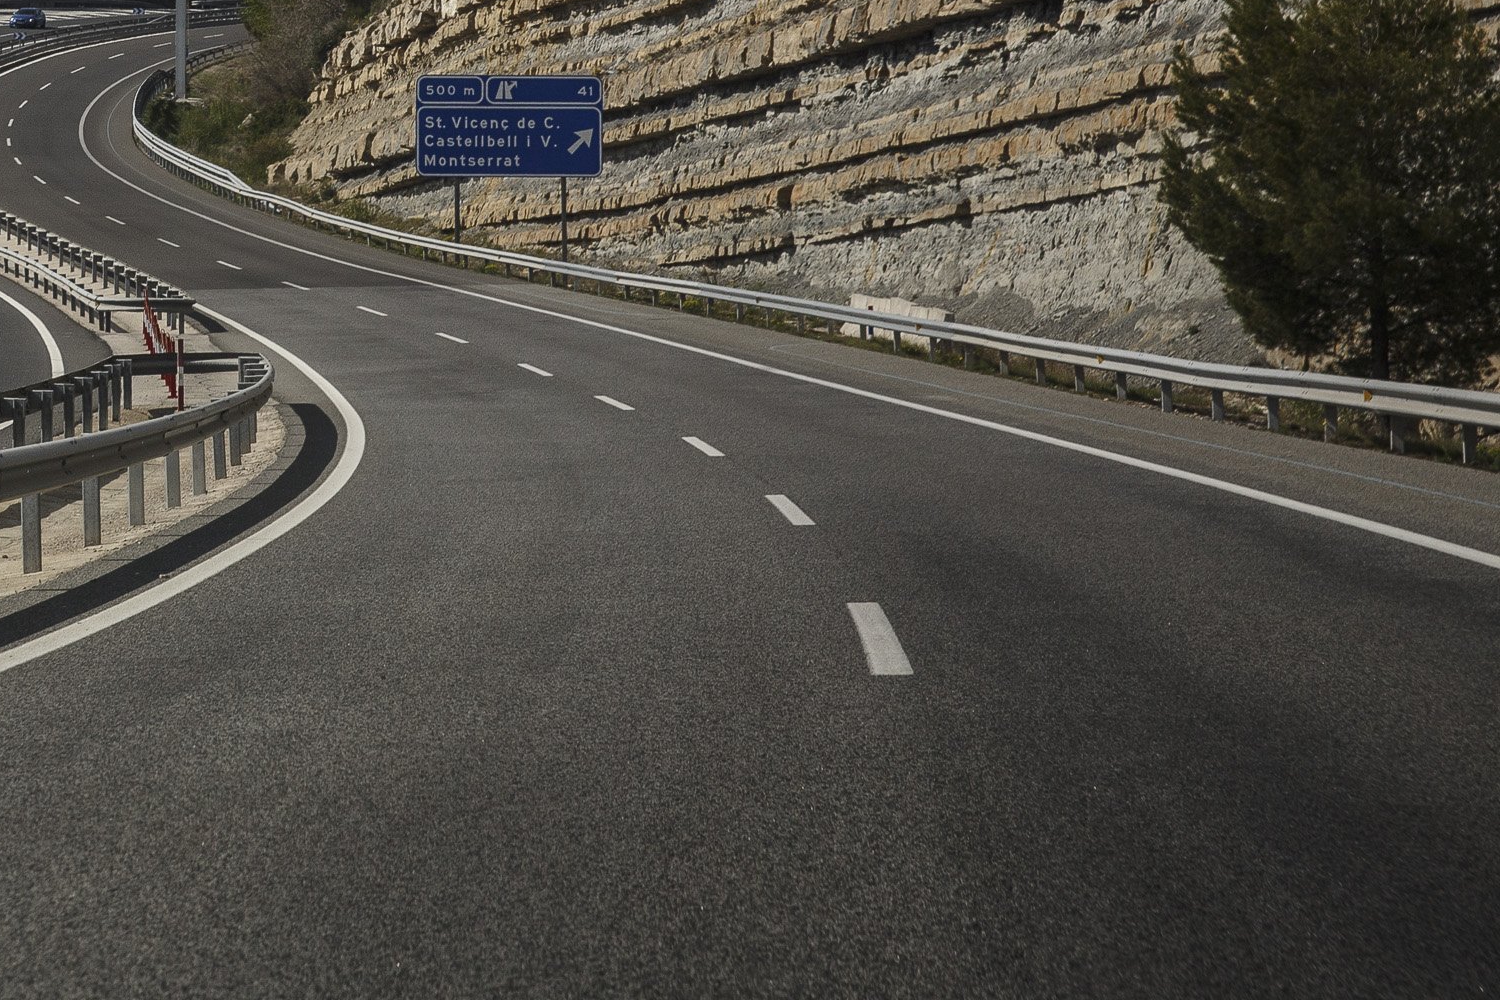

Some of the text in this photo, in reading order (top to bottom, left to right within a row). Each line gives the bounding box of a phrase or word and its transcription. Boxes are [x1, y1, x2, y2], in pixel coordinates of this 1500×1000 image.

[427, 85, 455, 95] 500
[578, 86, 592, 96] 41
[425, 116, 559, 130] St. Vicenç de C.
[425, 135, 557, 147] Castellbell i V.
[425, 155, 520, 166] Montserrat
